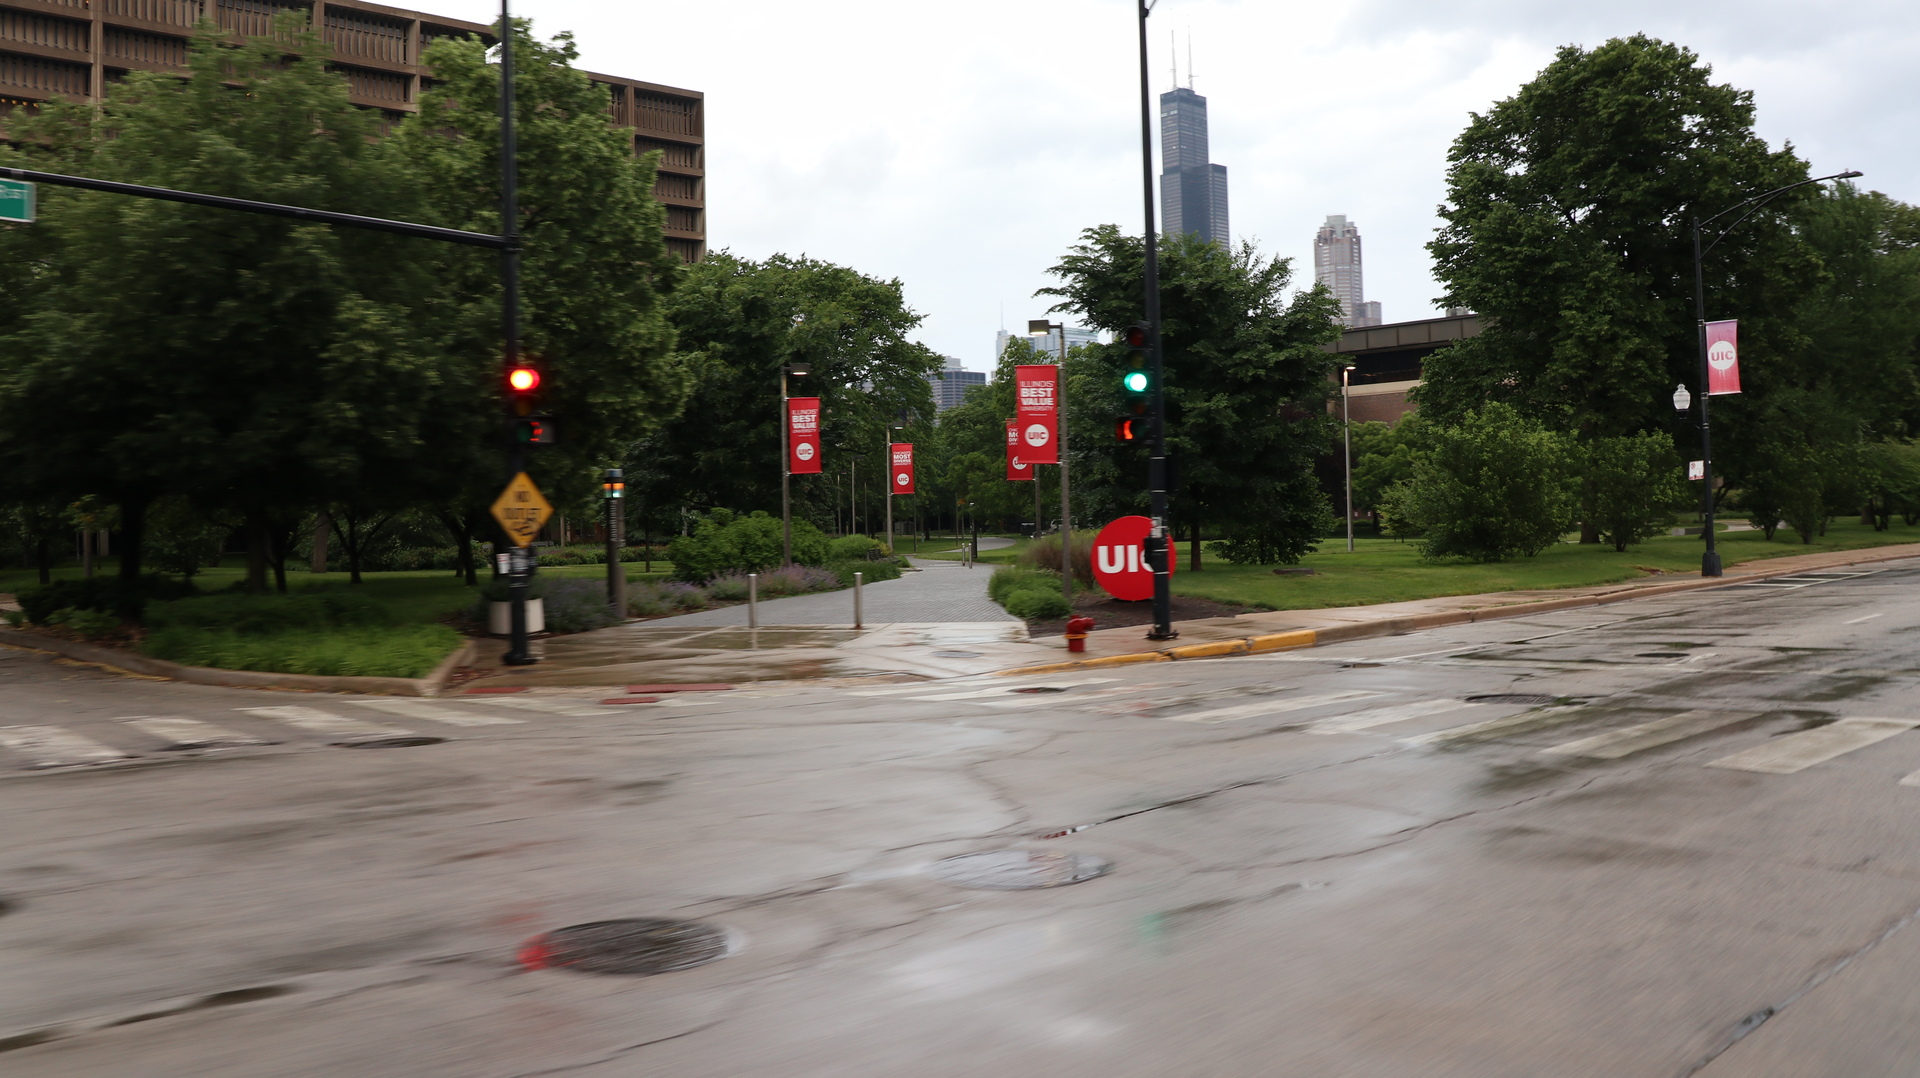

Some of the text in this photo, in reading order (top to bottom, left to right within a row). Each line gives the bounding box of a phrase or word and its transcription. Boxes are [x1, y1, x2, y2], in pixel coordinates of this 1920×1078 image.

[1711, 350, 1734, 361] UIC
[1020, 388, 1053, 397] BEST
[1020, 397, 1054, 406] VALUE
[1027, 431, 1047, 440] UIC
